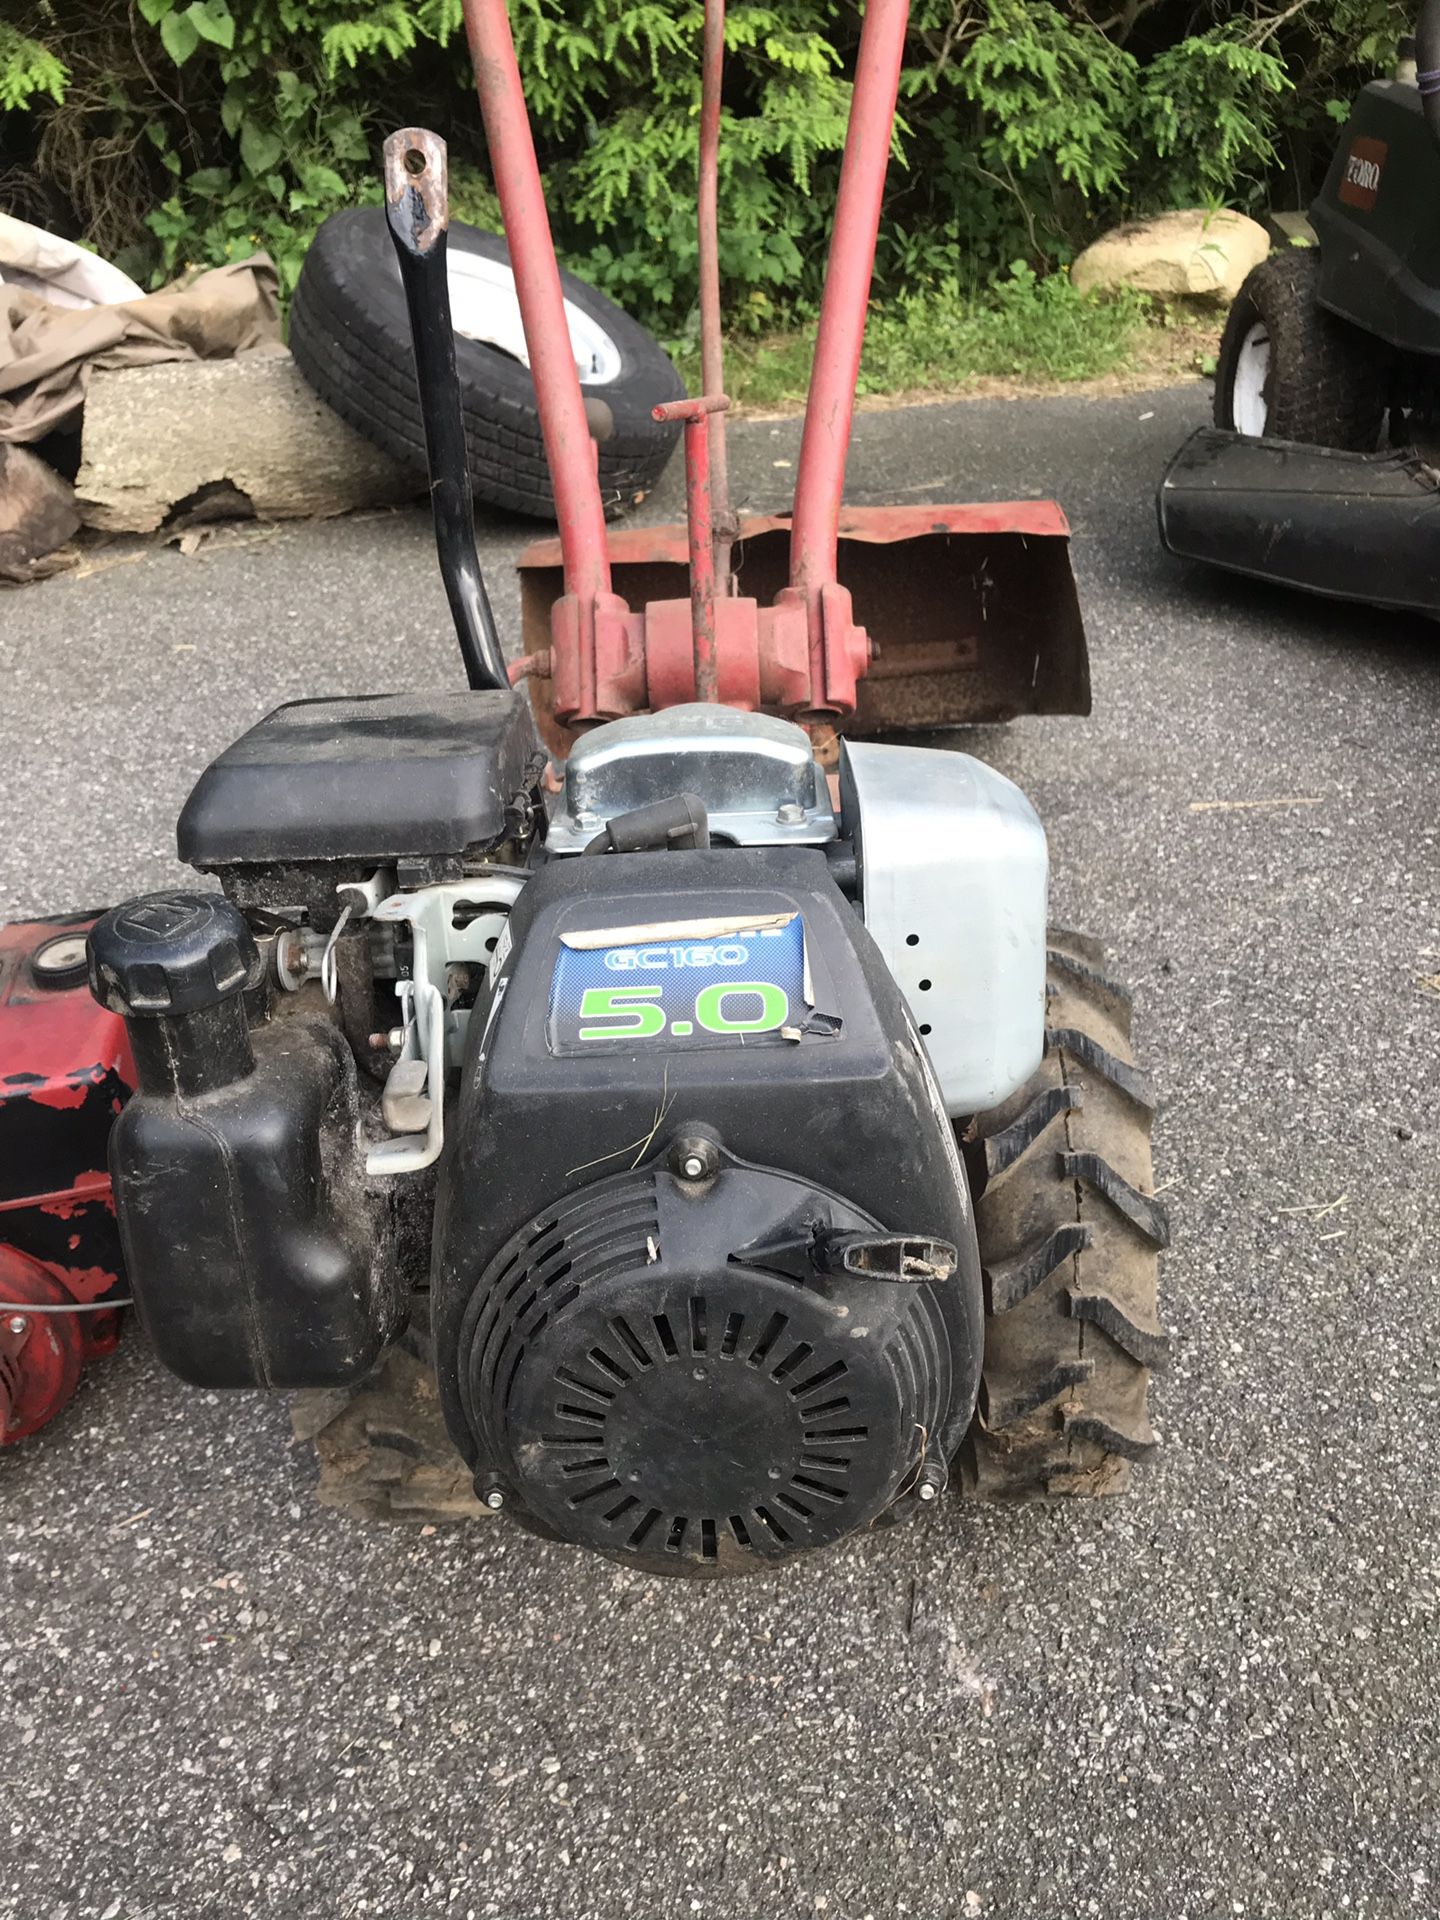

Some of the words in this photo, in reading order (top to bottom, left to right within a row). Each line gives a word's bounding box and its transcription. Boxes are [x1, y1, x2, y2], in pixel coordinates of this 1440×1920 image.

[1347, 154, 1380, 192] TORO
[604, 944, 749, 970] GC160
[579, 981, 789, 1041] 5.0
